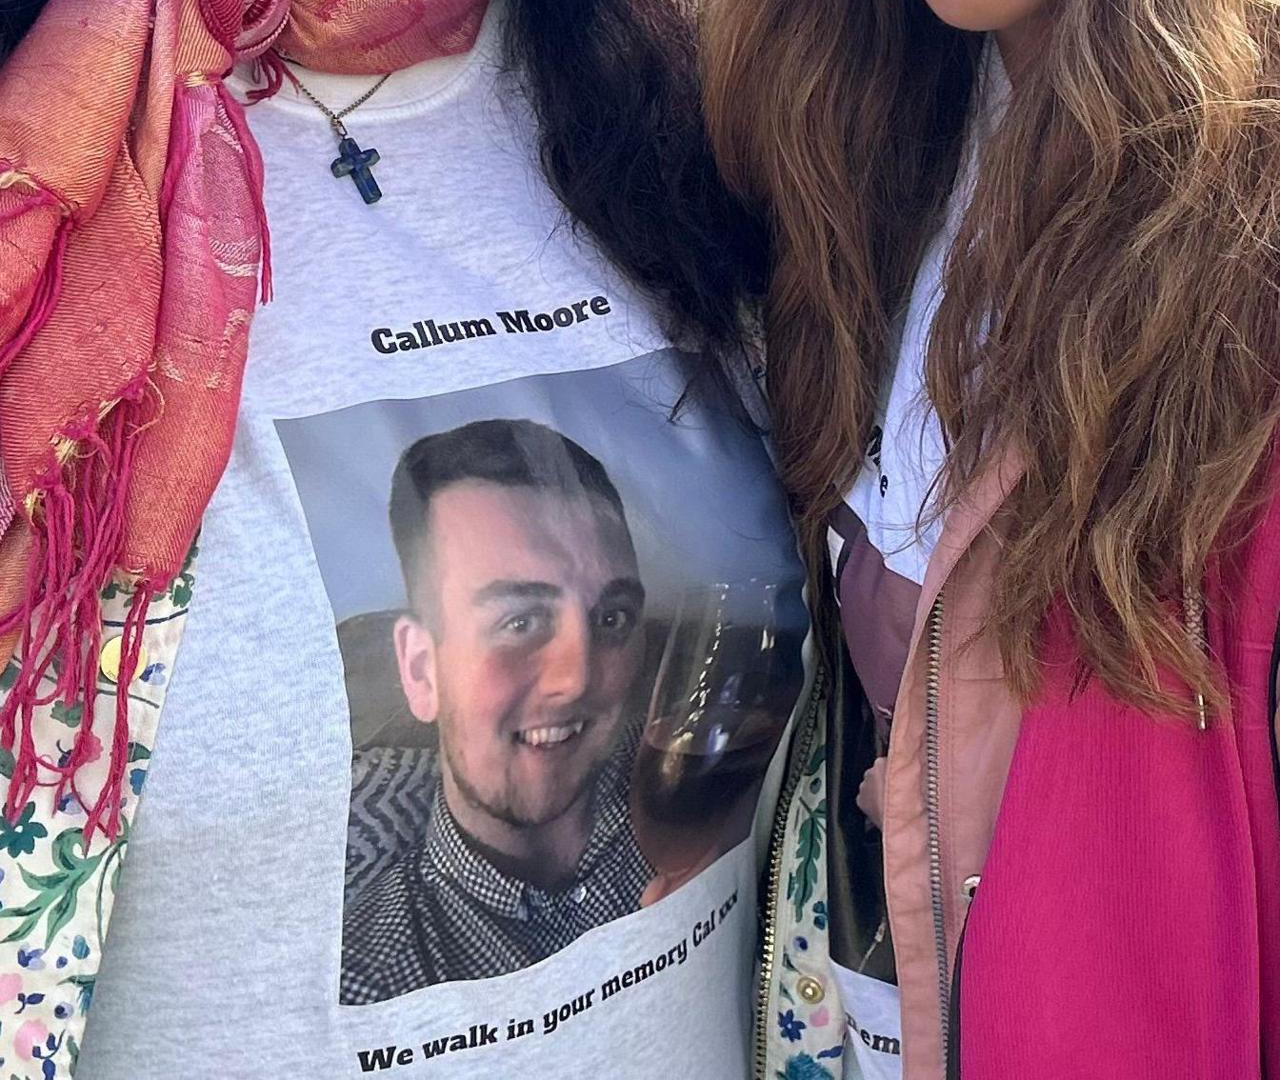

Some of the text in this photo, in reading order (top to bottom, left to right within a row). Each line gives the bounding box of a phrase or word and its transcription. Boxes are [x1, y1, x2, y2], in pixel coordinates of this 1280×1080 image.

[371, 295, 611, 355] Callum Moore
[357, 1046, 414, 1073] We
[422, 1023, 499, 1060] walk
[506, 1018, 535, 1041] in
[543, 988, 596, 1035] your
[601, 938, 688, 1002] memory
[692, 909, 716, 948] Cal
